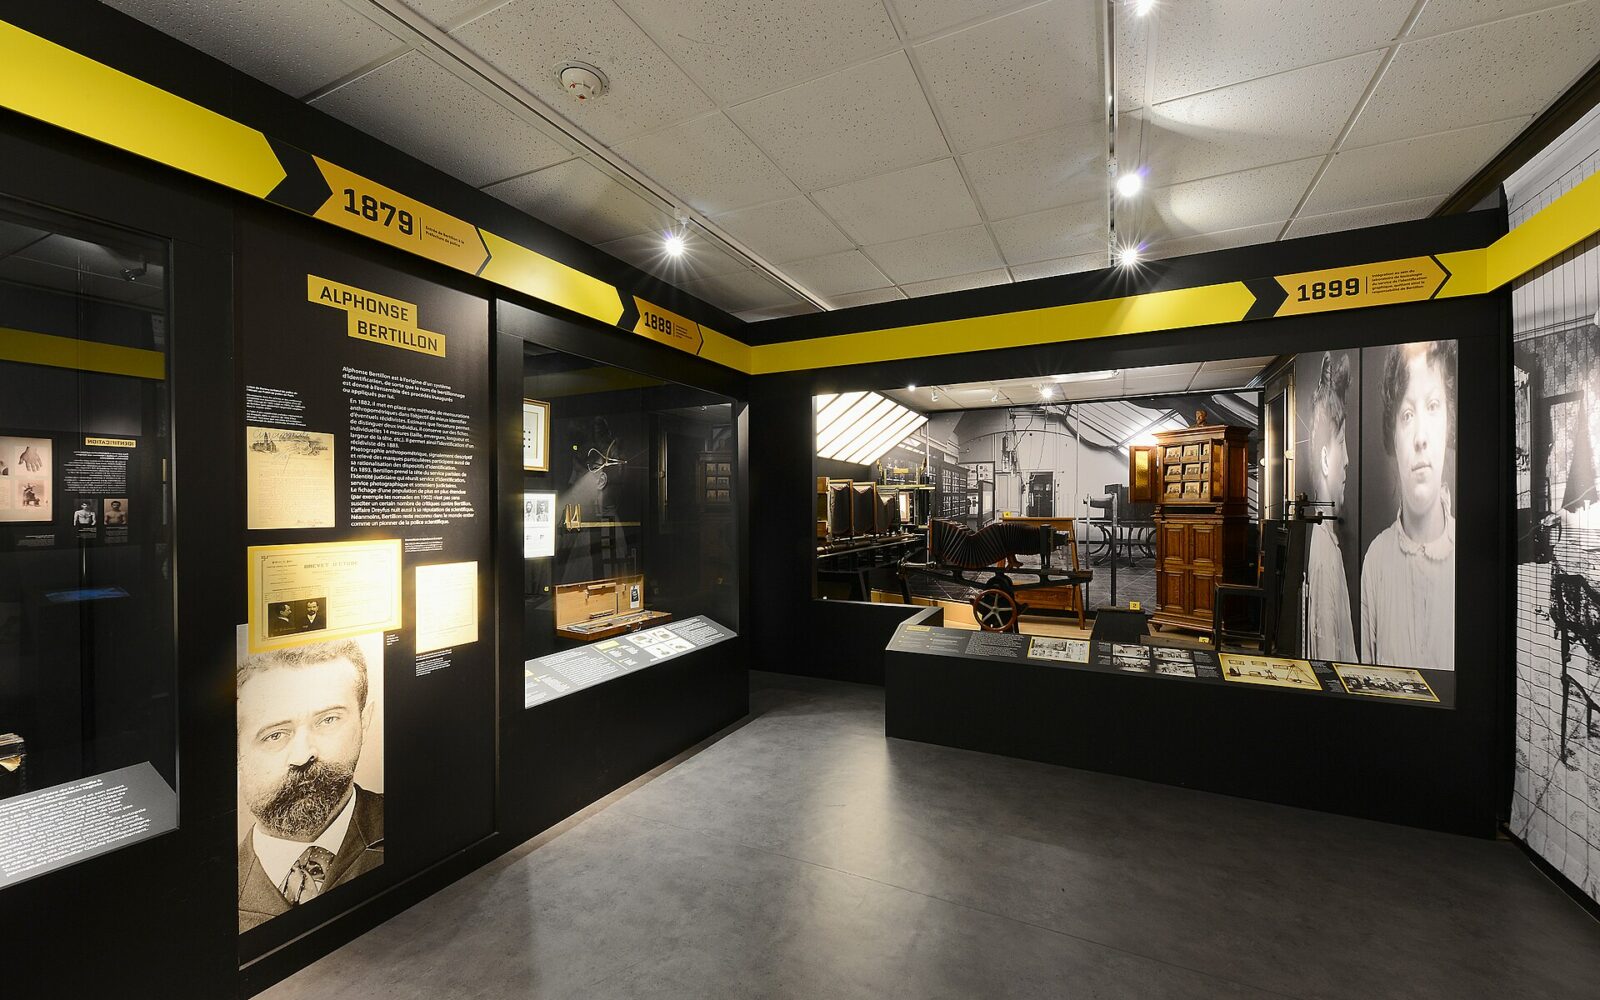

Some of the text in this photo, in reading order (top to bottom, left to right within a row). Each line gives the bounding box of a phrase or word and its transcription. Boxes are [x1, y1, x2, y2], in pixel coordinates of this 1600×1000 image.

[344, 188, 412, 236] 1879
[1297, 278, 1360, 302] 1899
[320, 286, 408, 322] ALPHONSE
[644, 312, 671, 335] 1889
[358, 320, 437, 351] BERTILLON
[343, 367, 368, 376] Alphonse
[369, 371, 390, 380] Bertillon
[403, 377, 422, 385] l'origine
[343, 373, 383, 386] d'identification,
[374, 385, 400, 394] l'ensemble
[350, 406, 397, 416] anthropométriques
[358, 420, 383, 428] distinguer
